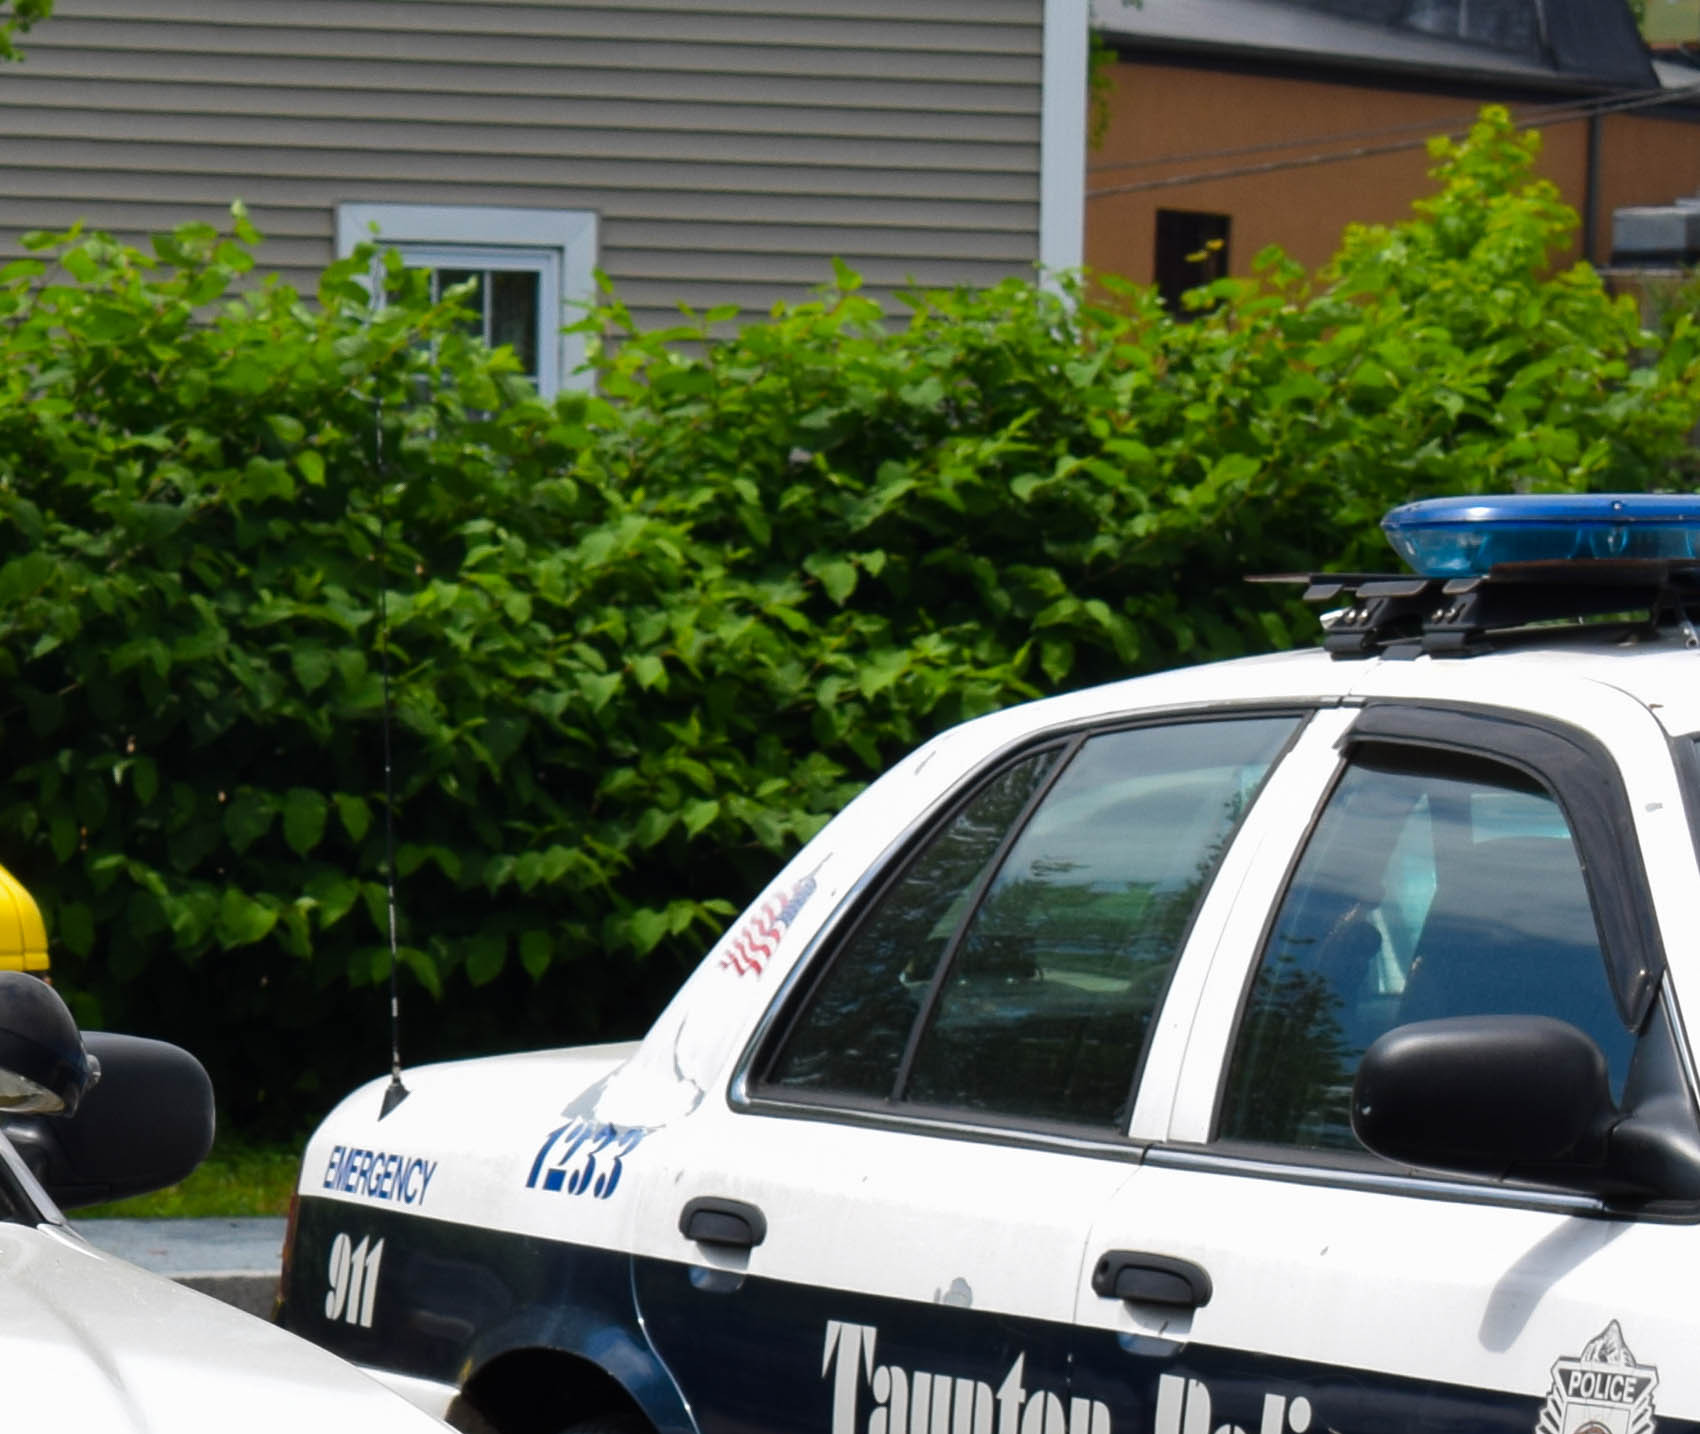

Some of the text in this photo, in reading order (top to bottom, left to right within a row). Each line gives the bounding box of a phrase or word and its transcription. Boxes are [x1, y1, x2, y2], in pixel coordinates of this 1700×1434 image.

[323, 1145, 438, 1205] EMERGENCY
[325, 1232, 384, 1328] 911
[1567, 1370, 1638, 1402] POLICE
